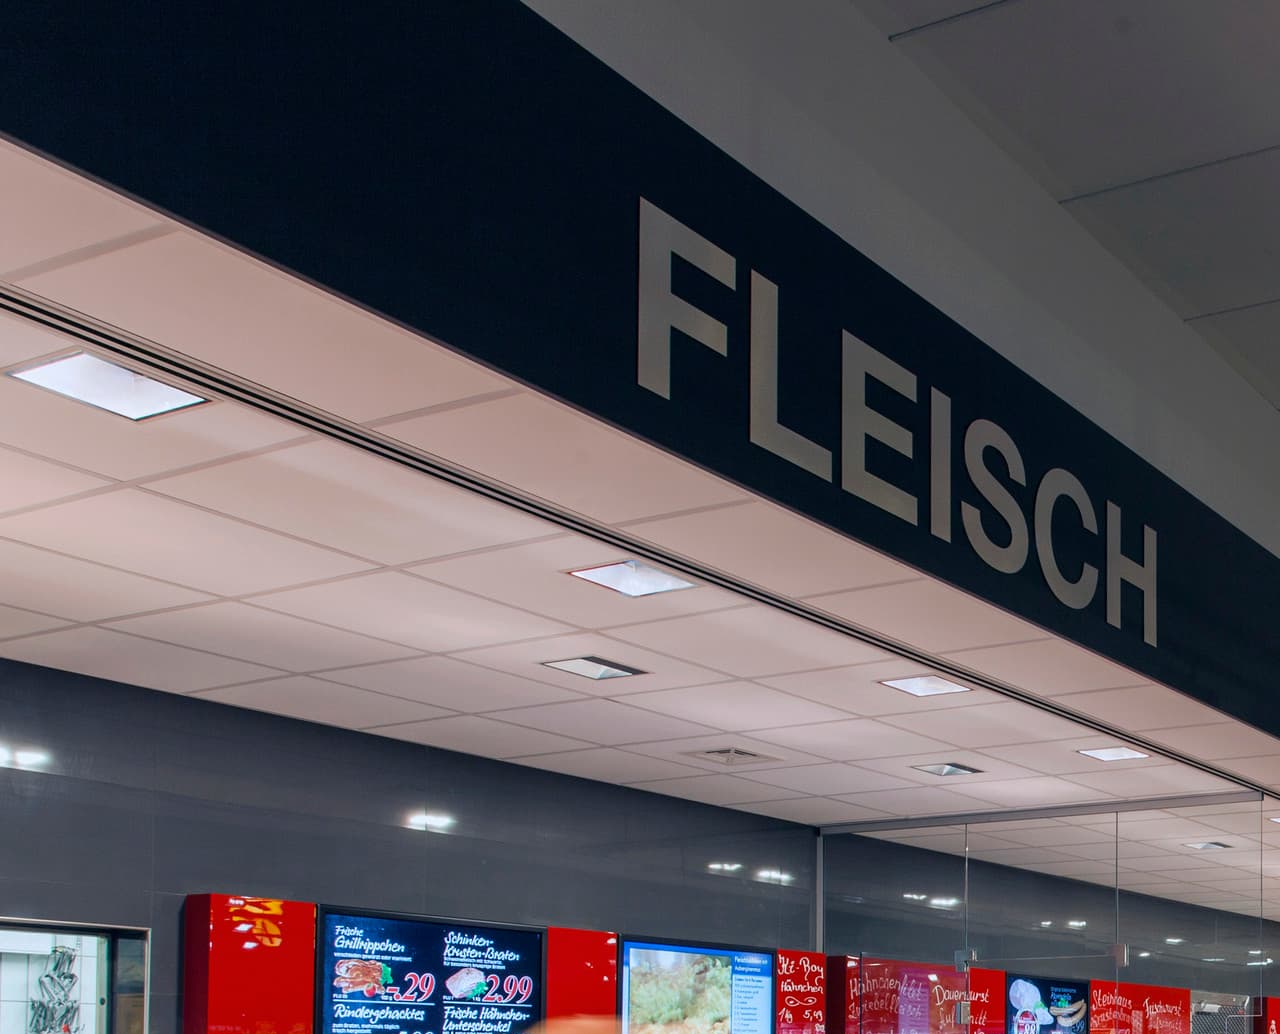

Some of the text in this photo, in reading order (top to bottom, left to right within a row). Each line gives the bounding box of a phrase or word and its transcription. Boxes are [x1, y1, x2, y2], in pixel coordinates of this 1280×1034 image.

[638, 196, 1157, 648] FLEISCH
[335, 925, 364, 937] Frische
[444, 931, 494, 946] Schinken-
[334, 936, 405, 954] Grillrippchen
[443, 944, 520, 960] Krusten-Braten
[481, 974, 534, 1004] 2.99
[781, 979, 823, 993] Hähnchen
[931, 984, 990, 1006] Dauerwurst
[333, 1003, 425, 1024] Rindergehacktes
[443, 1006, 530, 1021] Frische Hähnchen-
[442, 1019, 511, 1033] Unterschenkel
